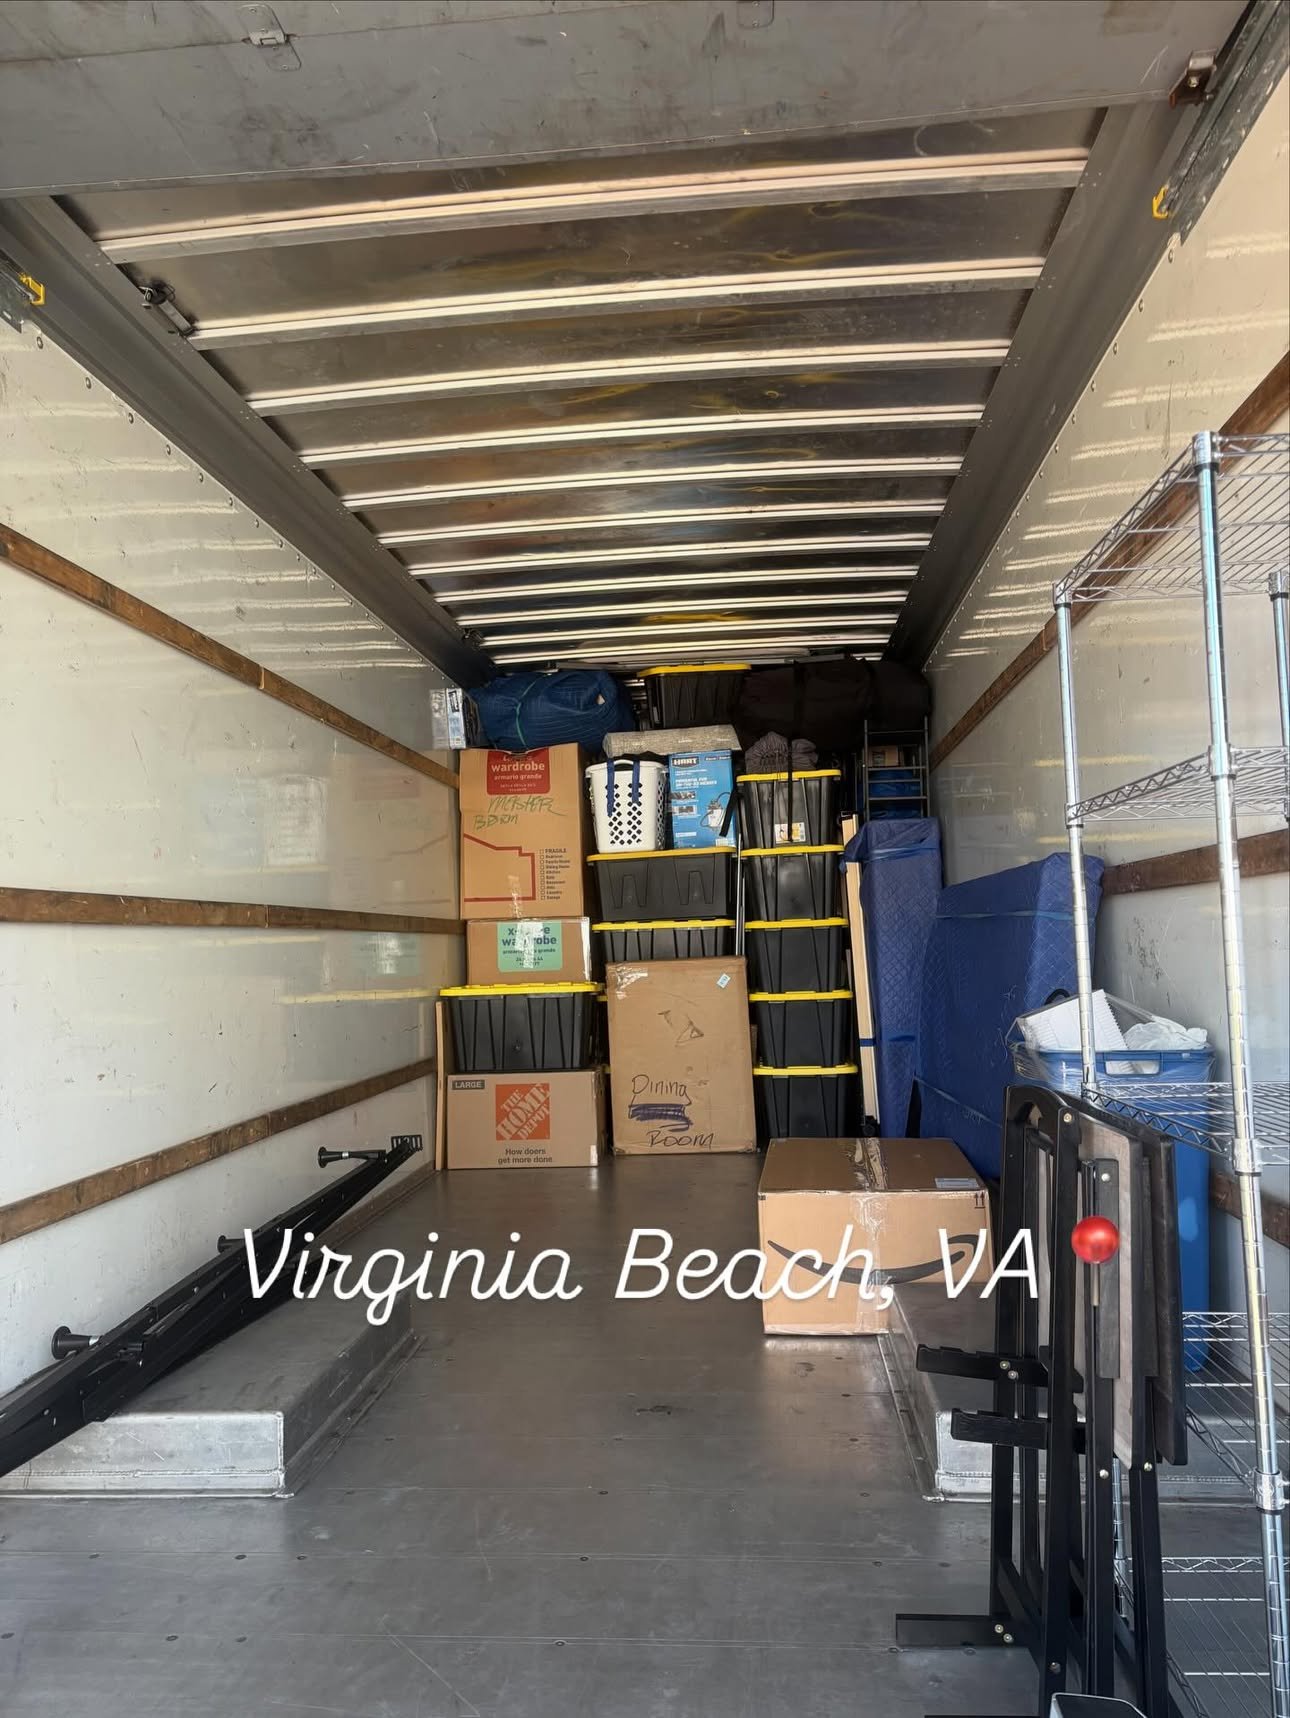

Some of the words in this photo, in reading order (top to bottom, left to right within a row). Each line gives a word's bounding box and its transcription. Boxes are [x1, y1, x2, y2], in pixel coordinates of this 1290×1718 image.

[491, 761, 545, 772] wardrobe
[455, 1081, 482, 1089] LARGE
[631, 1074, 692, 1106] Dining
[501, 1089, 524, 1112] THE
[496, 1083, 551, 1141] HOME
[517, 1103, 550, 1140] DEPOT
[505, 1148, 523, 1156] How
[498, 1157, 511, 1165] get
